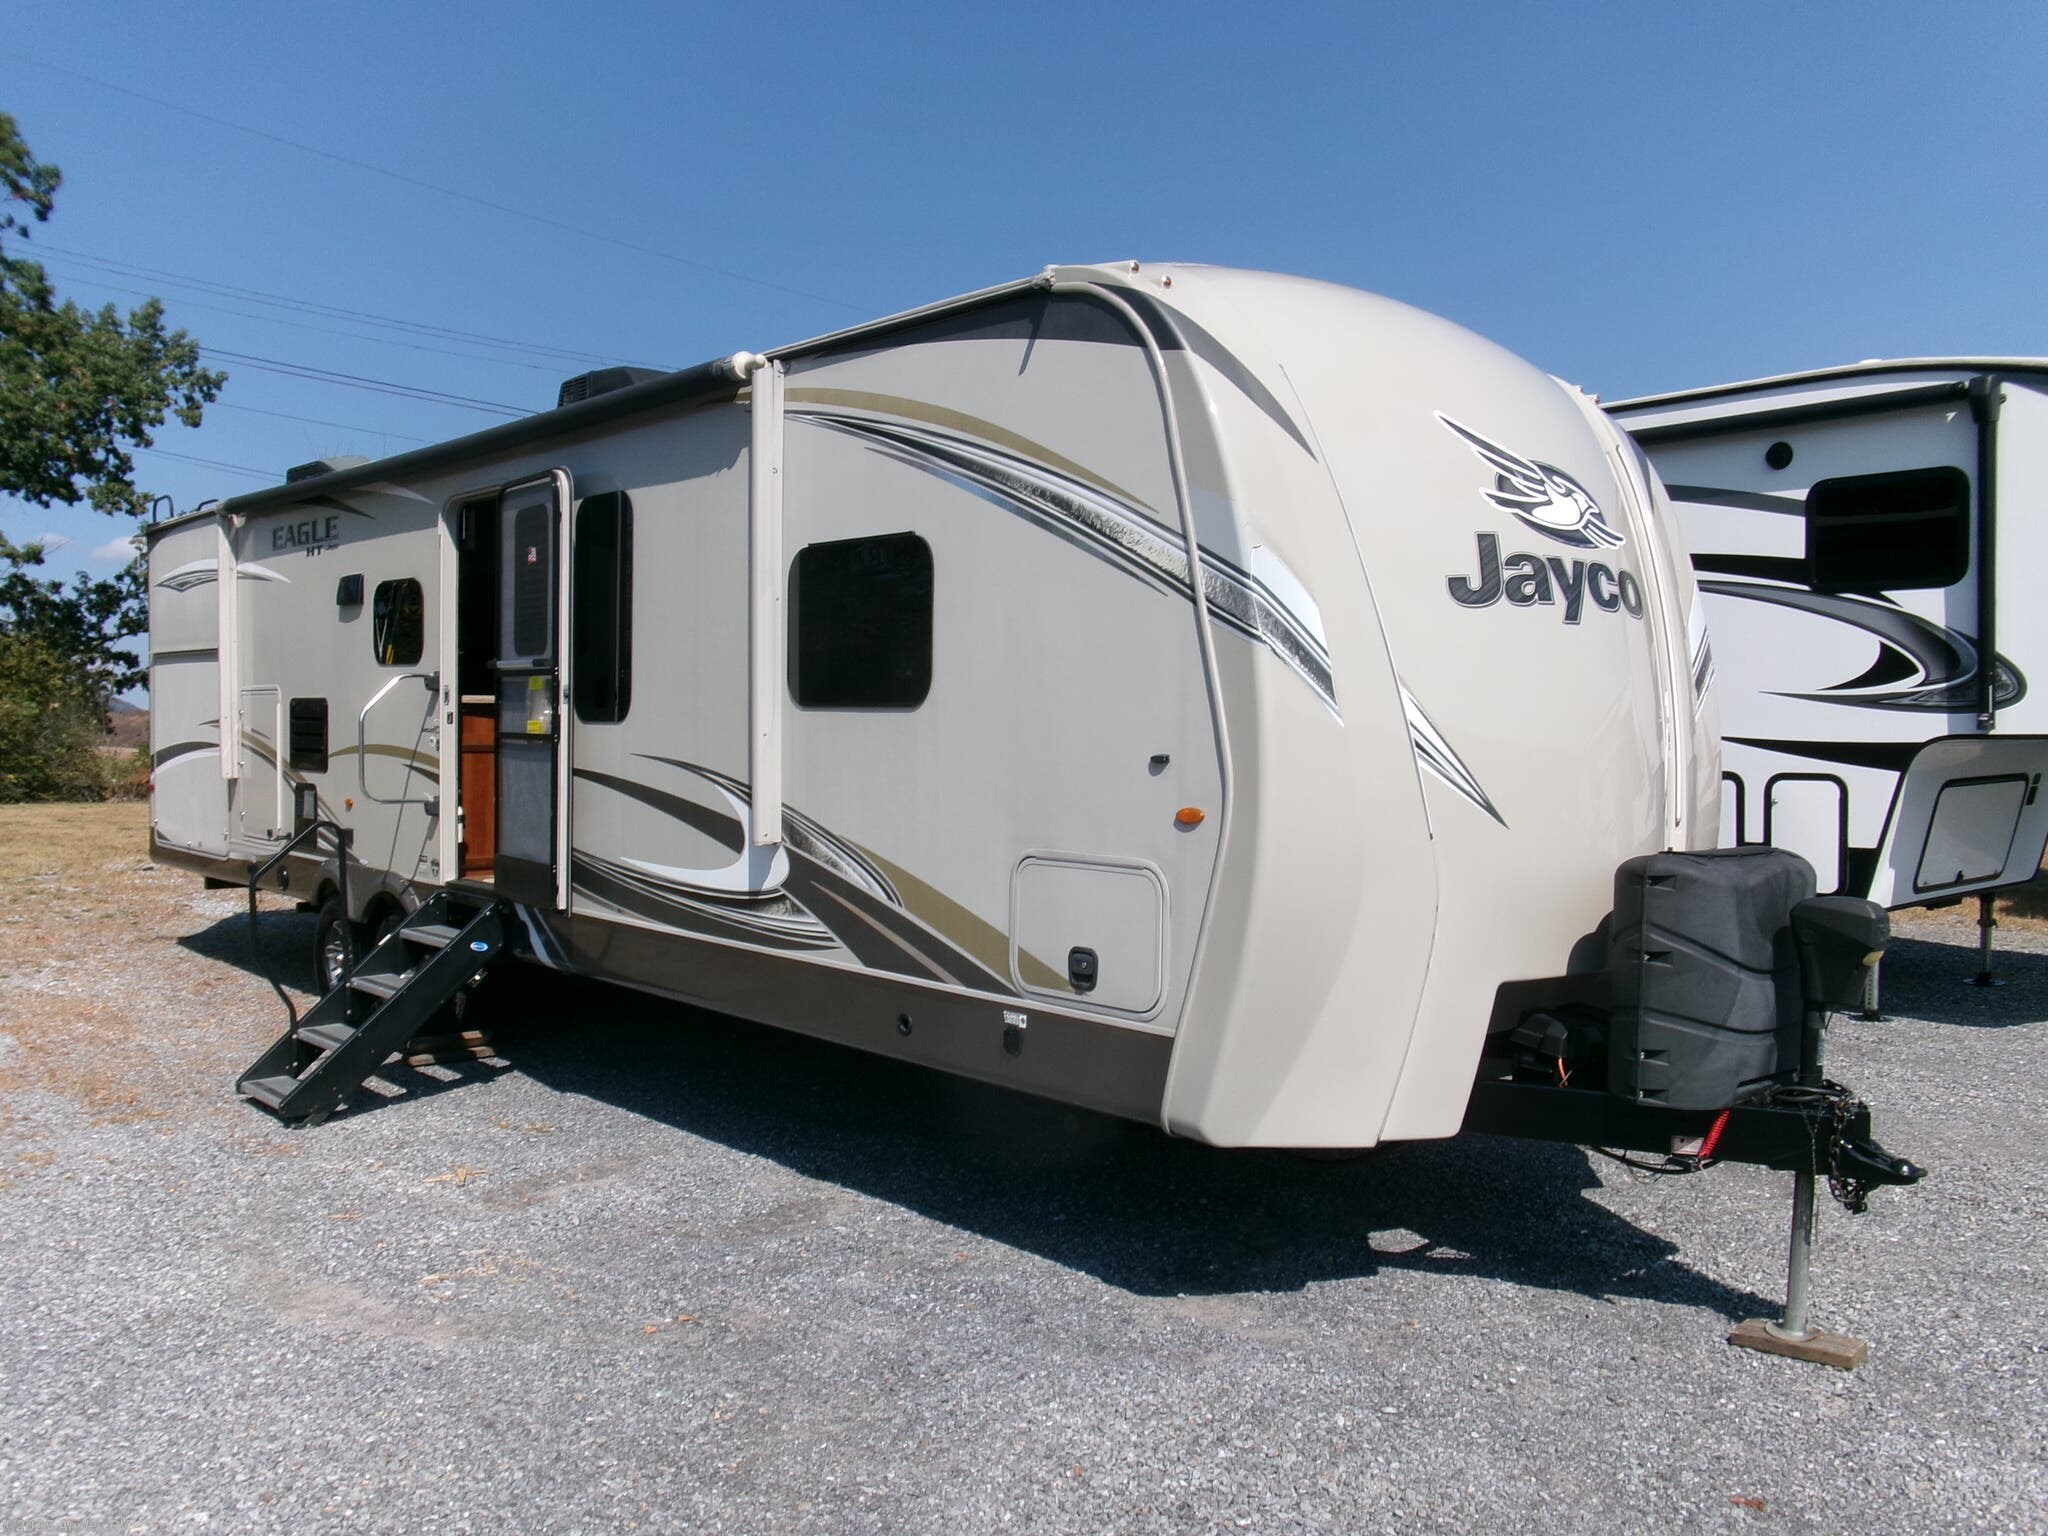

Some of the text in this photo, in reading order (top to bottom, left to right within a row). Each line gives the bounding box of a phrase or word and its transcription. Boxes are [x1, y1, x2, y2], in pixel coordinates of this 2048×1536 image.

[272, 515, 339, 551] EAGLE
[306, 544, 323, 557] HT
[1446, 530, 1643, 625] Jayco
